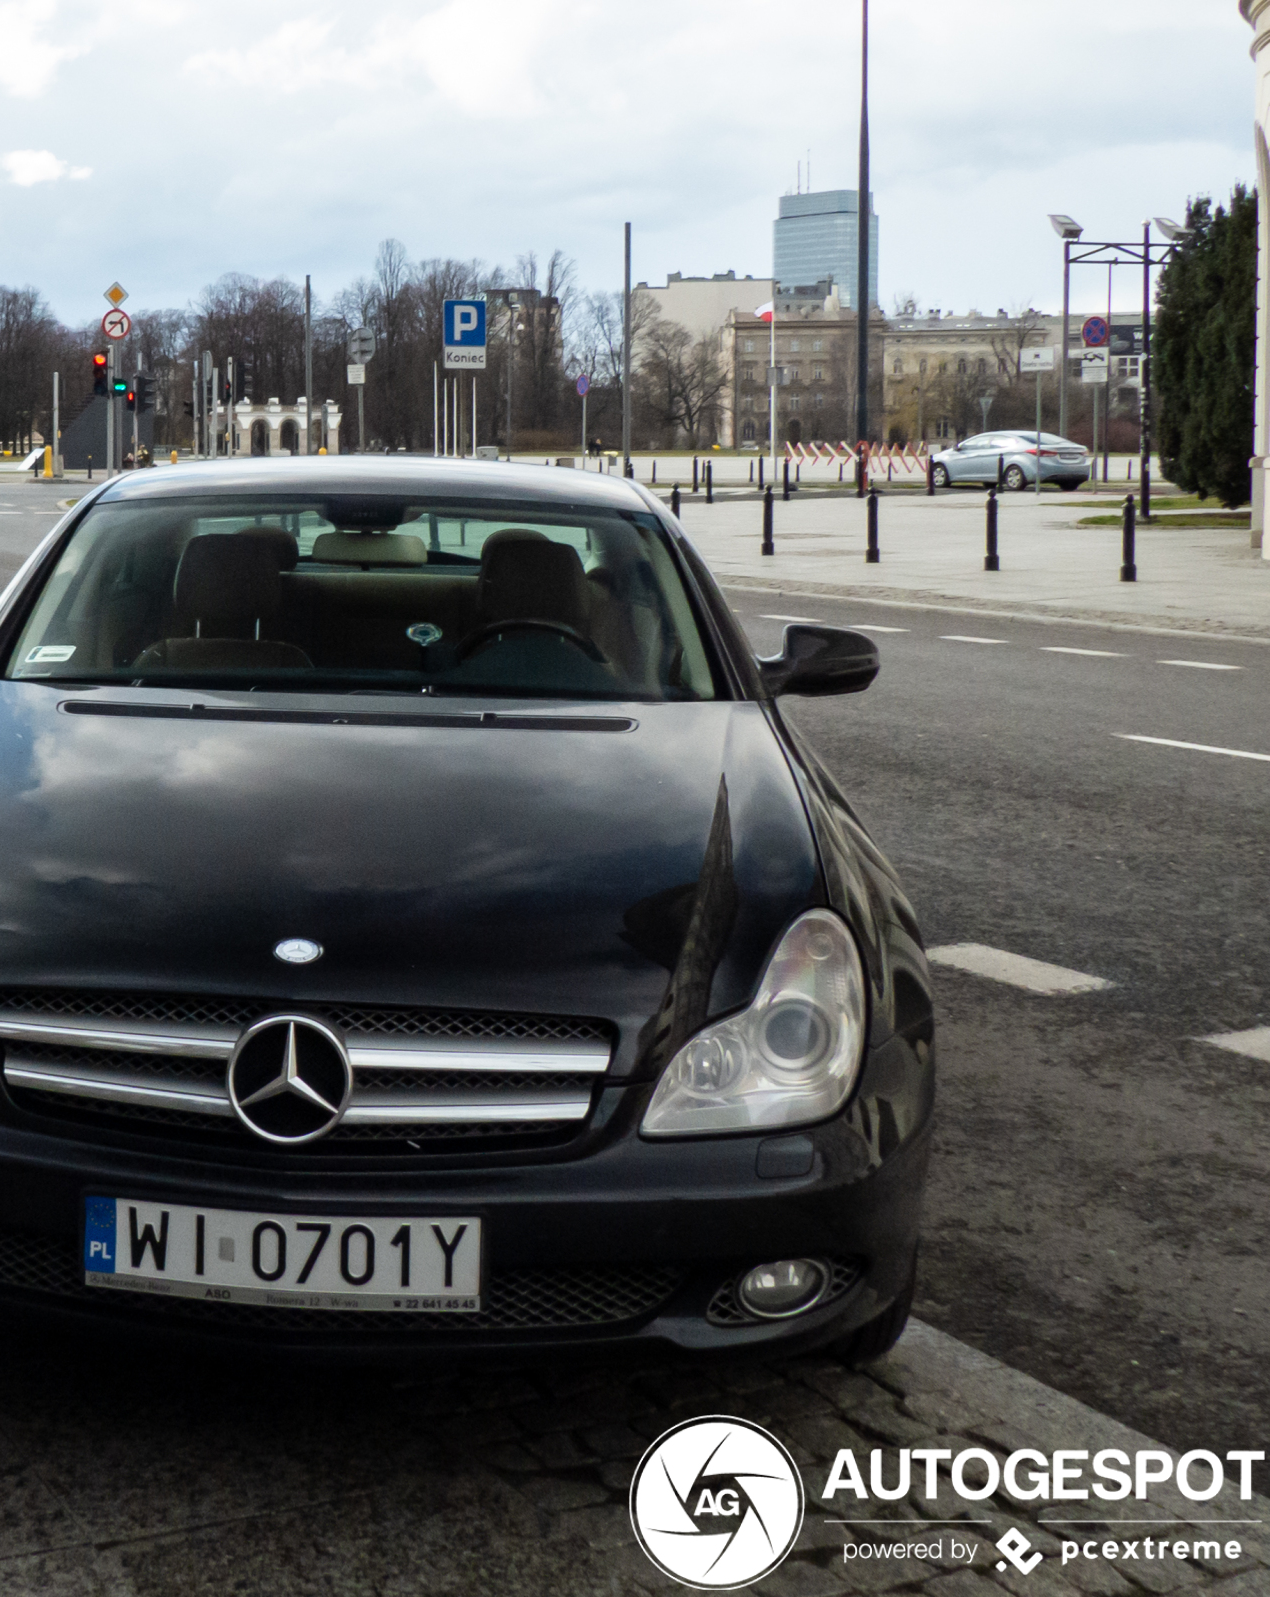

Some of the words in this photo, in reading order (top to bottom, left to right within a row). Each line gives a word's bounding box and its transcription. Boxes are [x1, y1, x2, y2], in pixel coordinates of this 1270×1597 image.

[454, 305, 478, 341] P
[446, 352, 484, 363] Koniec
[89, 1240, 112, 1260] PL
[128, 1206, 205, 1276] WI
[252, 1219, 468, 1288] 0701Y
[406, 1300, 419, 1309] 22
[422, 1300, 442, 1309] 641
[445, 1300, 459, 1309] 45
[462, 1300, 476, 1309] 45
